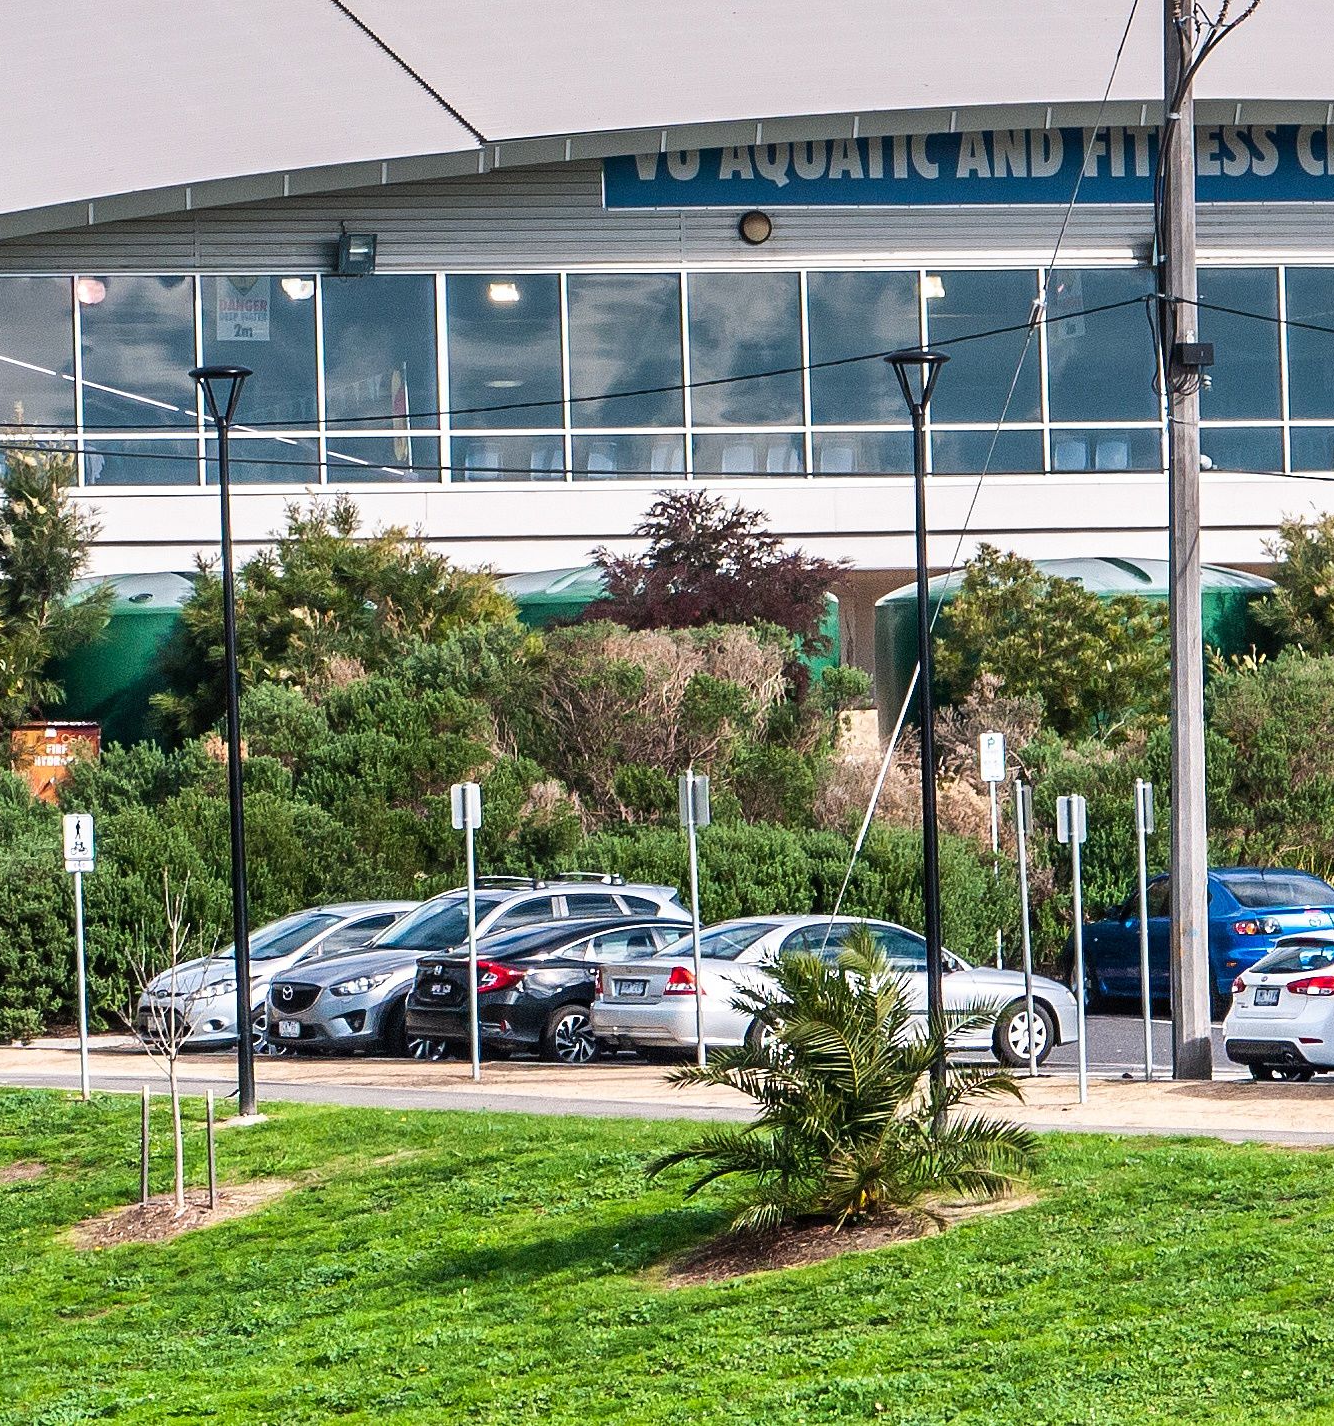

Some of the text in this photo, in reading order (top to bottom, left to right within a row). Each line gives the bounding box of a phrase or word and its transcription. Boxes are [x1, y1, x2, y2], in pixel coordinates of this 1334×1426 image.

[719, 132, 939, 187] AQUATIC
[956, 128, 1064, 178] AND
[1083, 125, 1279, 176] FITESS
[218, 300, 267, 311] DANGER
